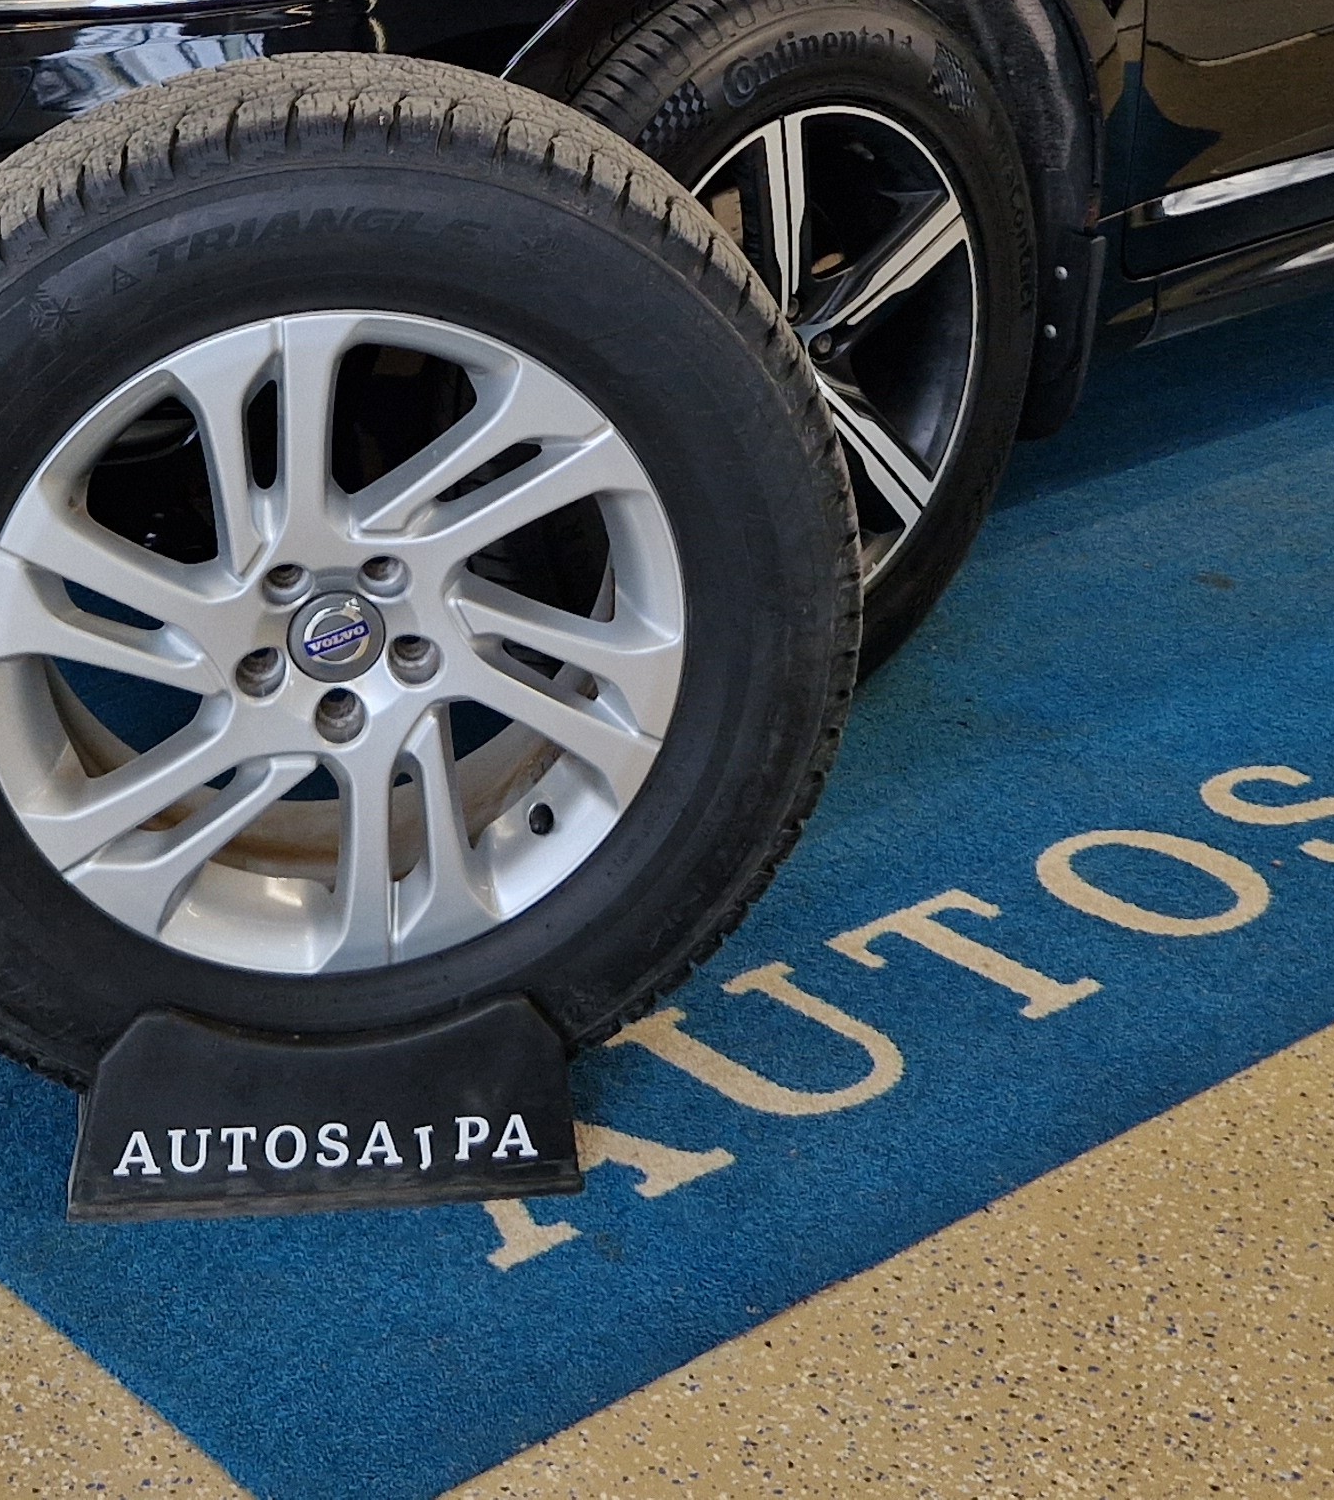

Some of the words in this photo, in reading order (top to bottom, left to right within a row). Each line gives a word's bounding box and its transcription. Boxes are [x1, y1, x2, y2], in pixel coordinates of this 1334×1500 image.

[722, 26, 895, 107] Continental
[147, 206, 493, 274] TRIANGLE
[307, 624, 365, 652] VOLVO
